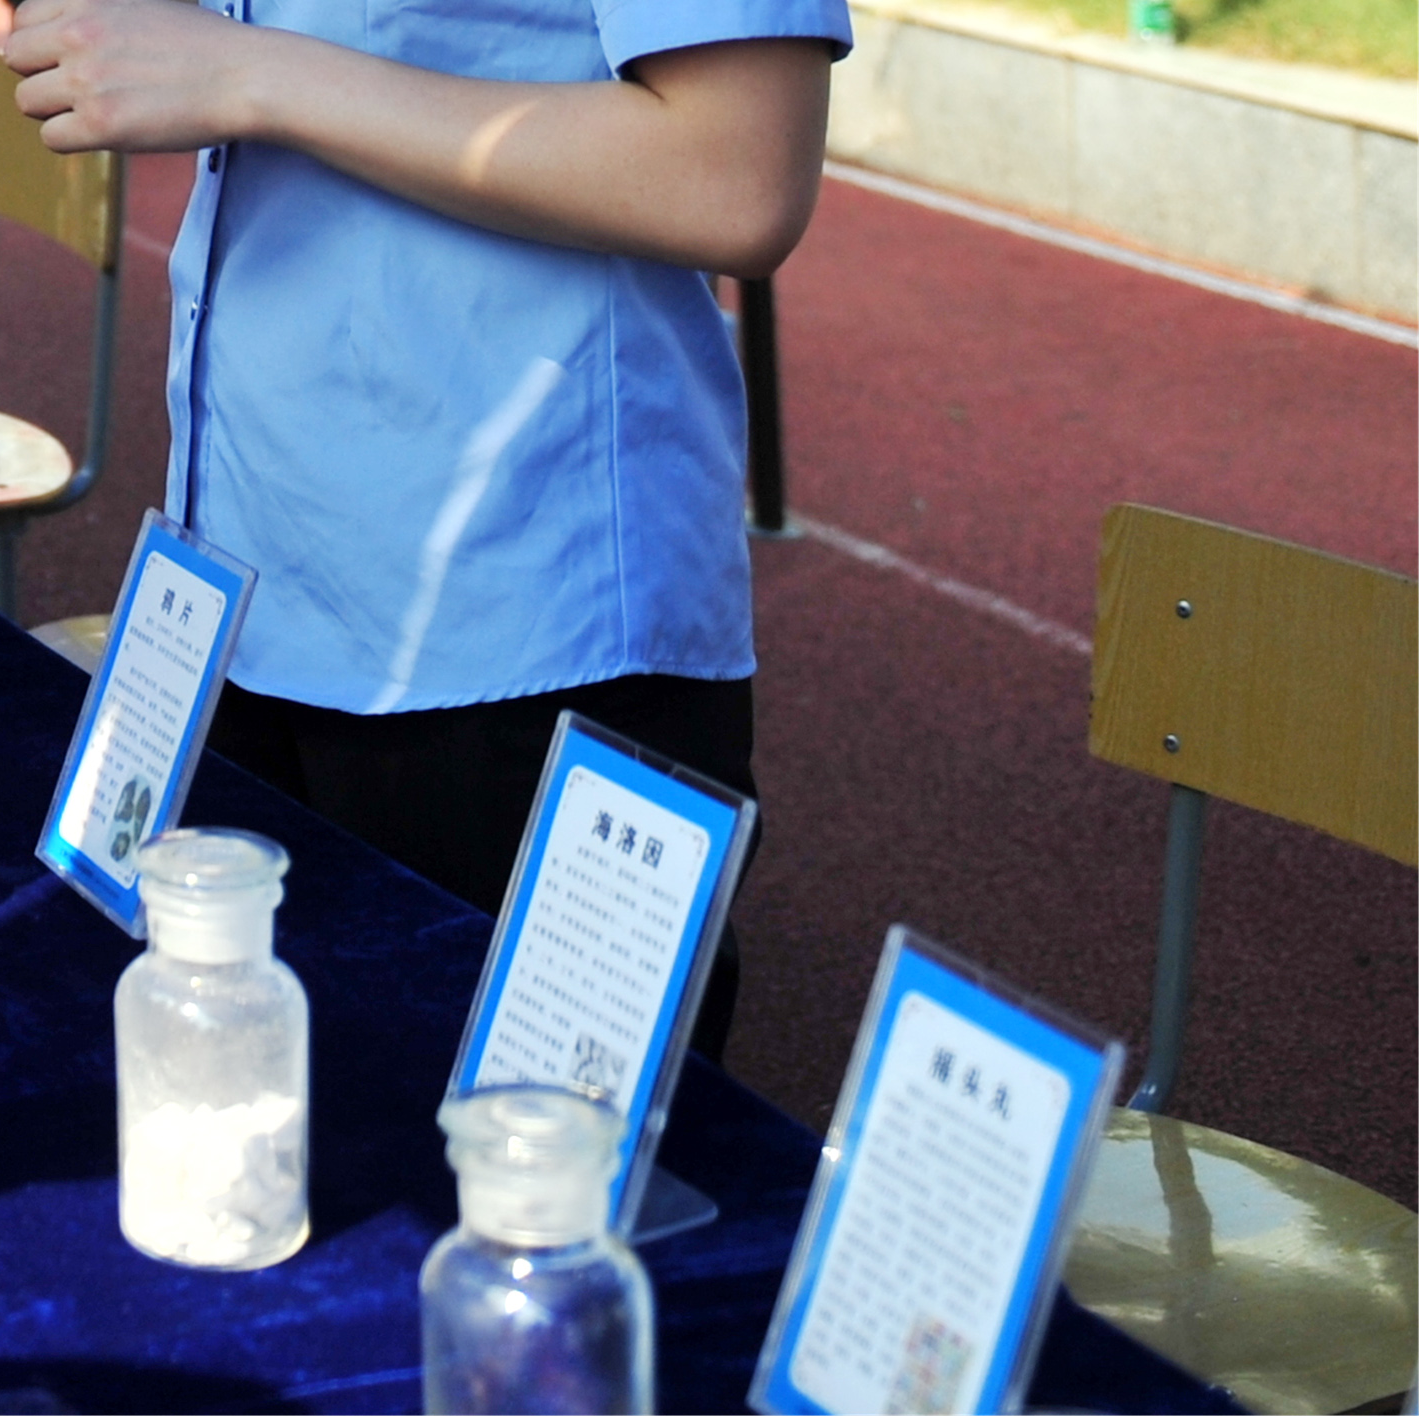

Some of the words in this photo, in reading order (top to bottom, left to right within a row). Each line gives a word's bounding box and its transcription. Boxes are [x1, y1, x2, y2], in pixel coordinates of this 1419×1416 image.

[592, 809, 664, 869] 海洛因
[930, 1046, 1011, 1121] 摇头丸
